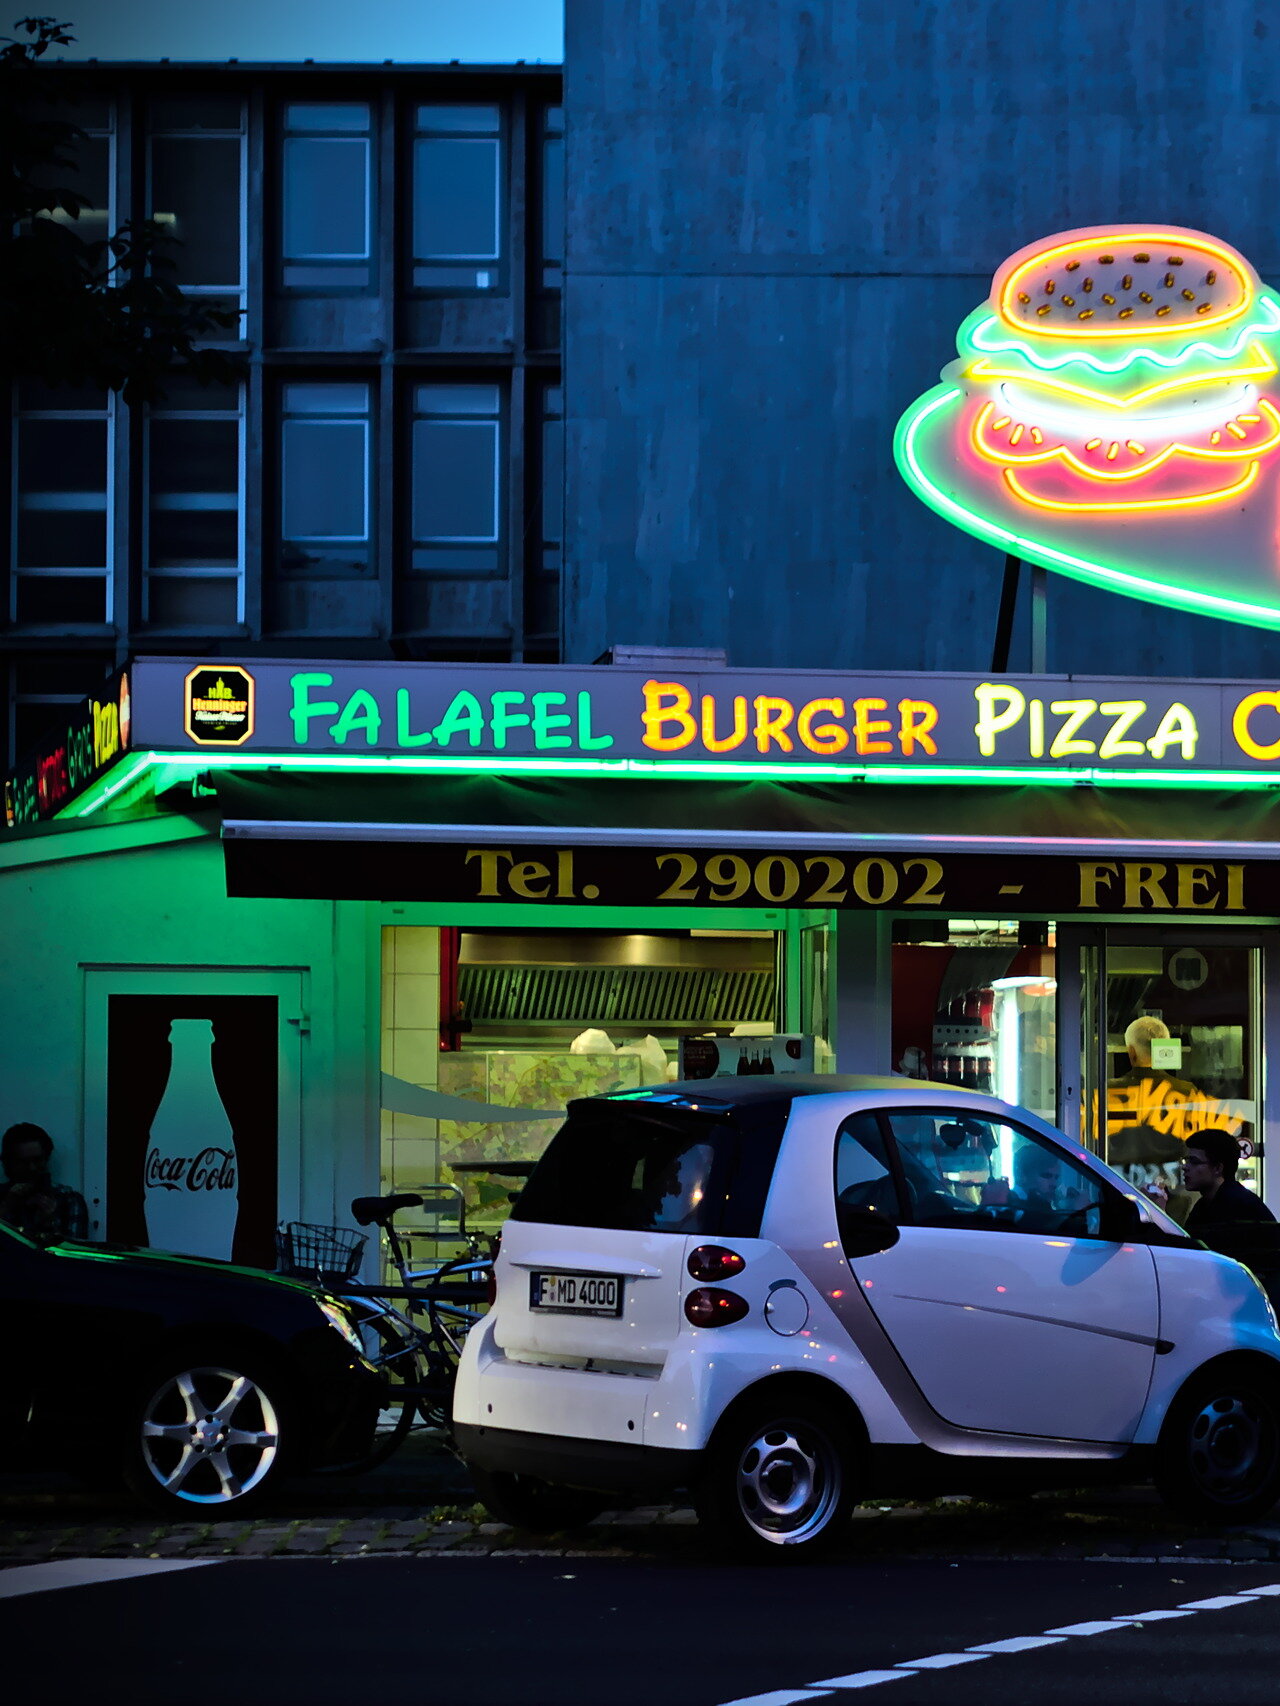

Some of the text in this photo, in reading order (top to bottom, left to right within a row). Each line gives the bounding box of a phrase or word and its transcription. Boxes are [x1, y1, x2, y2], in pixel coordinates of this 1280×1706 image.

[289, 672, 615, 751] FALAFEL
[640, 679, 940, 757] BURGER
[974, 682, 1199, 761] PIZZA
[464, 849, 600, 900] Tel.
[655, 853, 946, 905] 290202
[1076, 861, 1247, 911] FREI
[145, 1147, 236, 1192] Coca-Cola
[540, 1278, 615, 1306] F MD 4000
